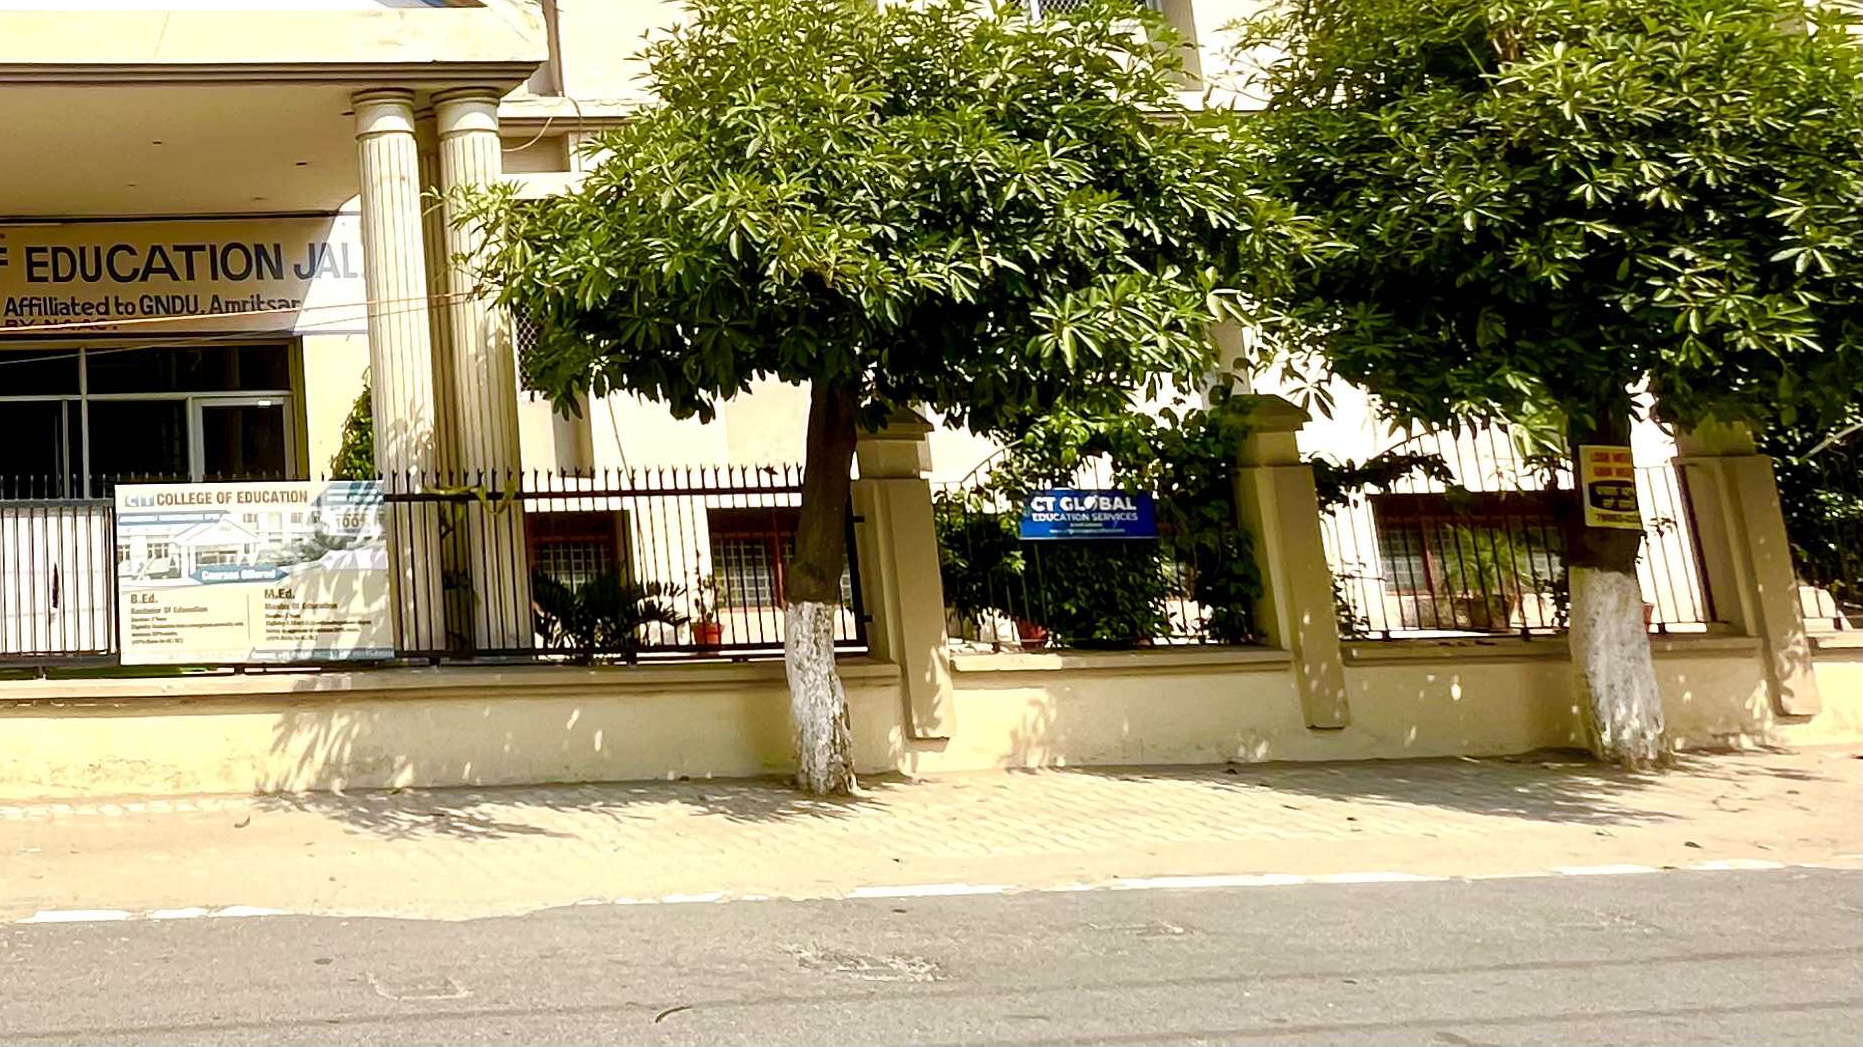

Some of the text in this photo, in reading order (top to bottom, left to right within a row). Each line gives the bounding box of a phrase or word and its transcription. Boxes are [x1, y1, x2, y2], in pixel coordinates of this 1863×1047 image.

[26, 242, 285, 283] EDUCATION
[114, 296, 136, 316] to
[209, 293, 301, 314] Amritsar
[126, 490, 308, 507] CT COLLEGE OF EDUCATION
[1031, 495, 1137, 512] CT GLOBAL
[1032, 511, 1138, 522] EDUCATION SERVICES
[202, 568, 276, 581] Courses Offered
[264, 588, 295, 600] M.Ed.
